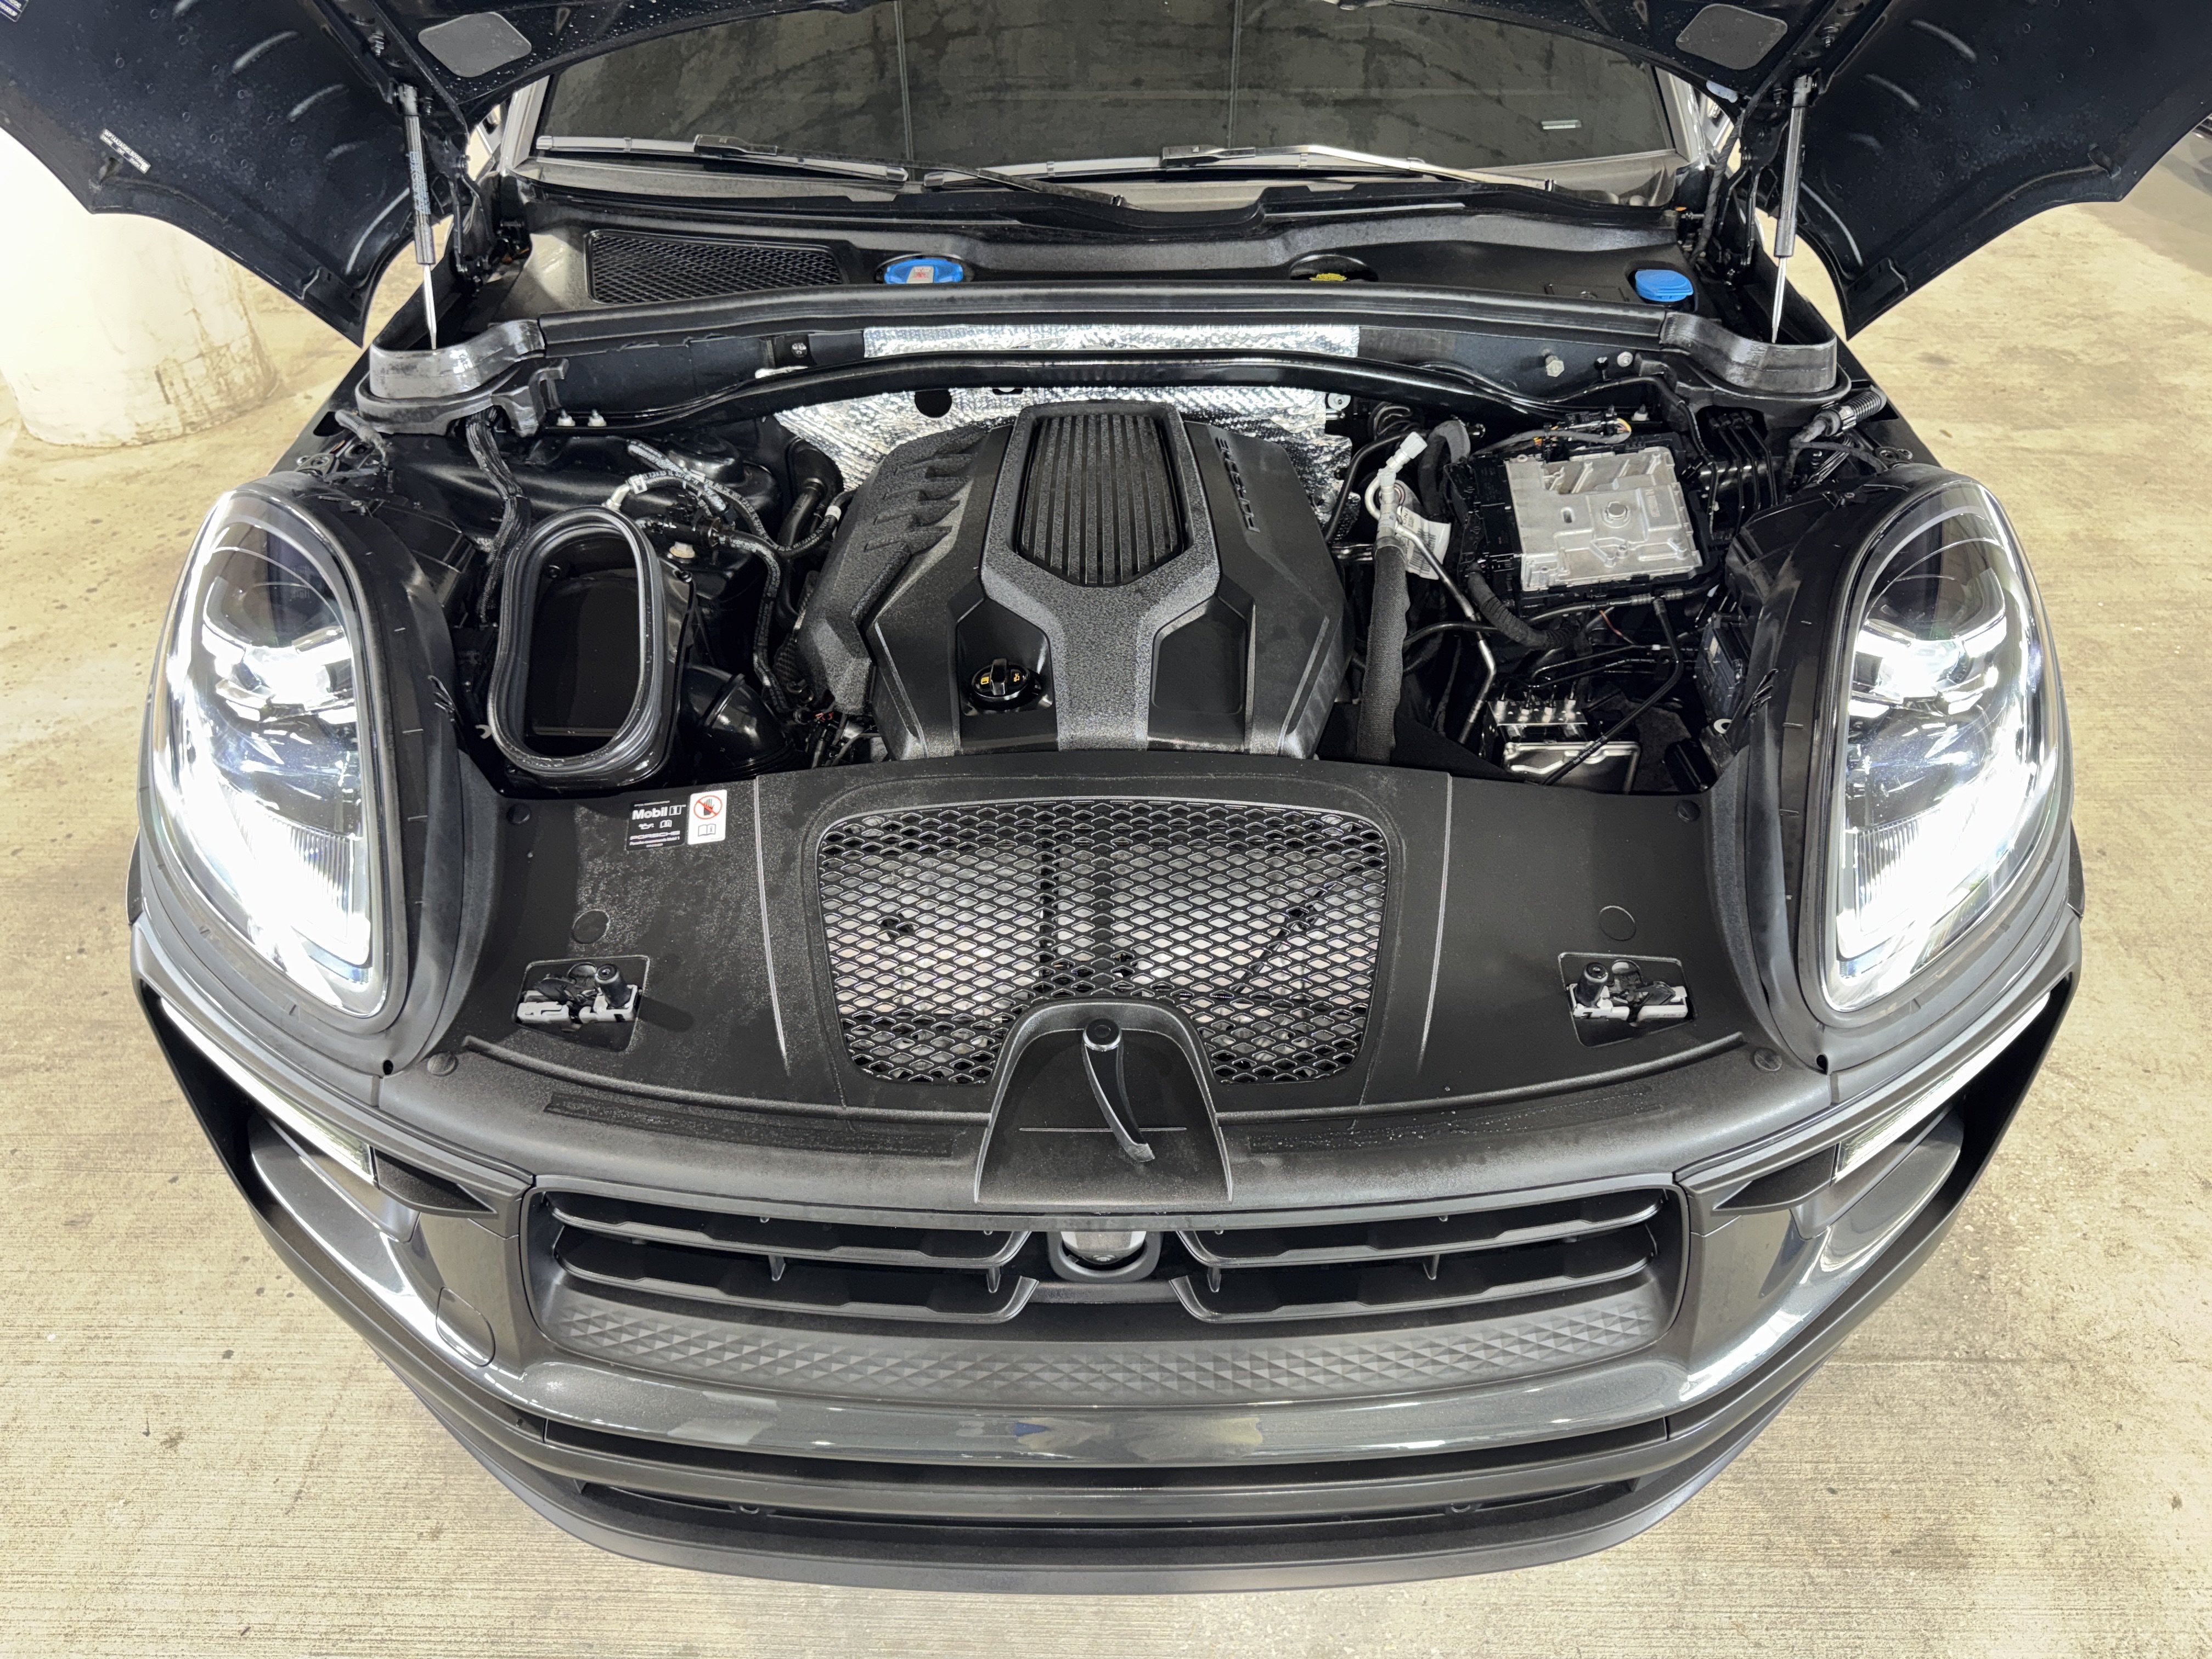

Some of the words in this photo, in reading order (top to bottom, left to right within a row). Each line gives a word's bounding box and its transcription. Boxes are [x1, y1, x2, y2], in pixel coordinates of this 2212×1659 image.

[1215, 437, 1260, 533] PORSCHE
[631, 806, 668, 820] Mobil
[629, 830, 680, 840] PORSCHE
